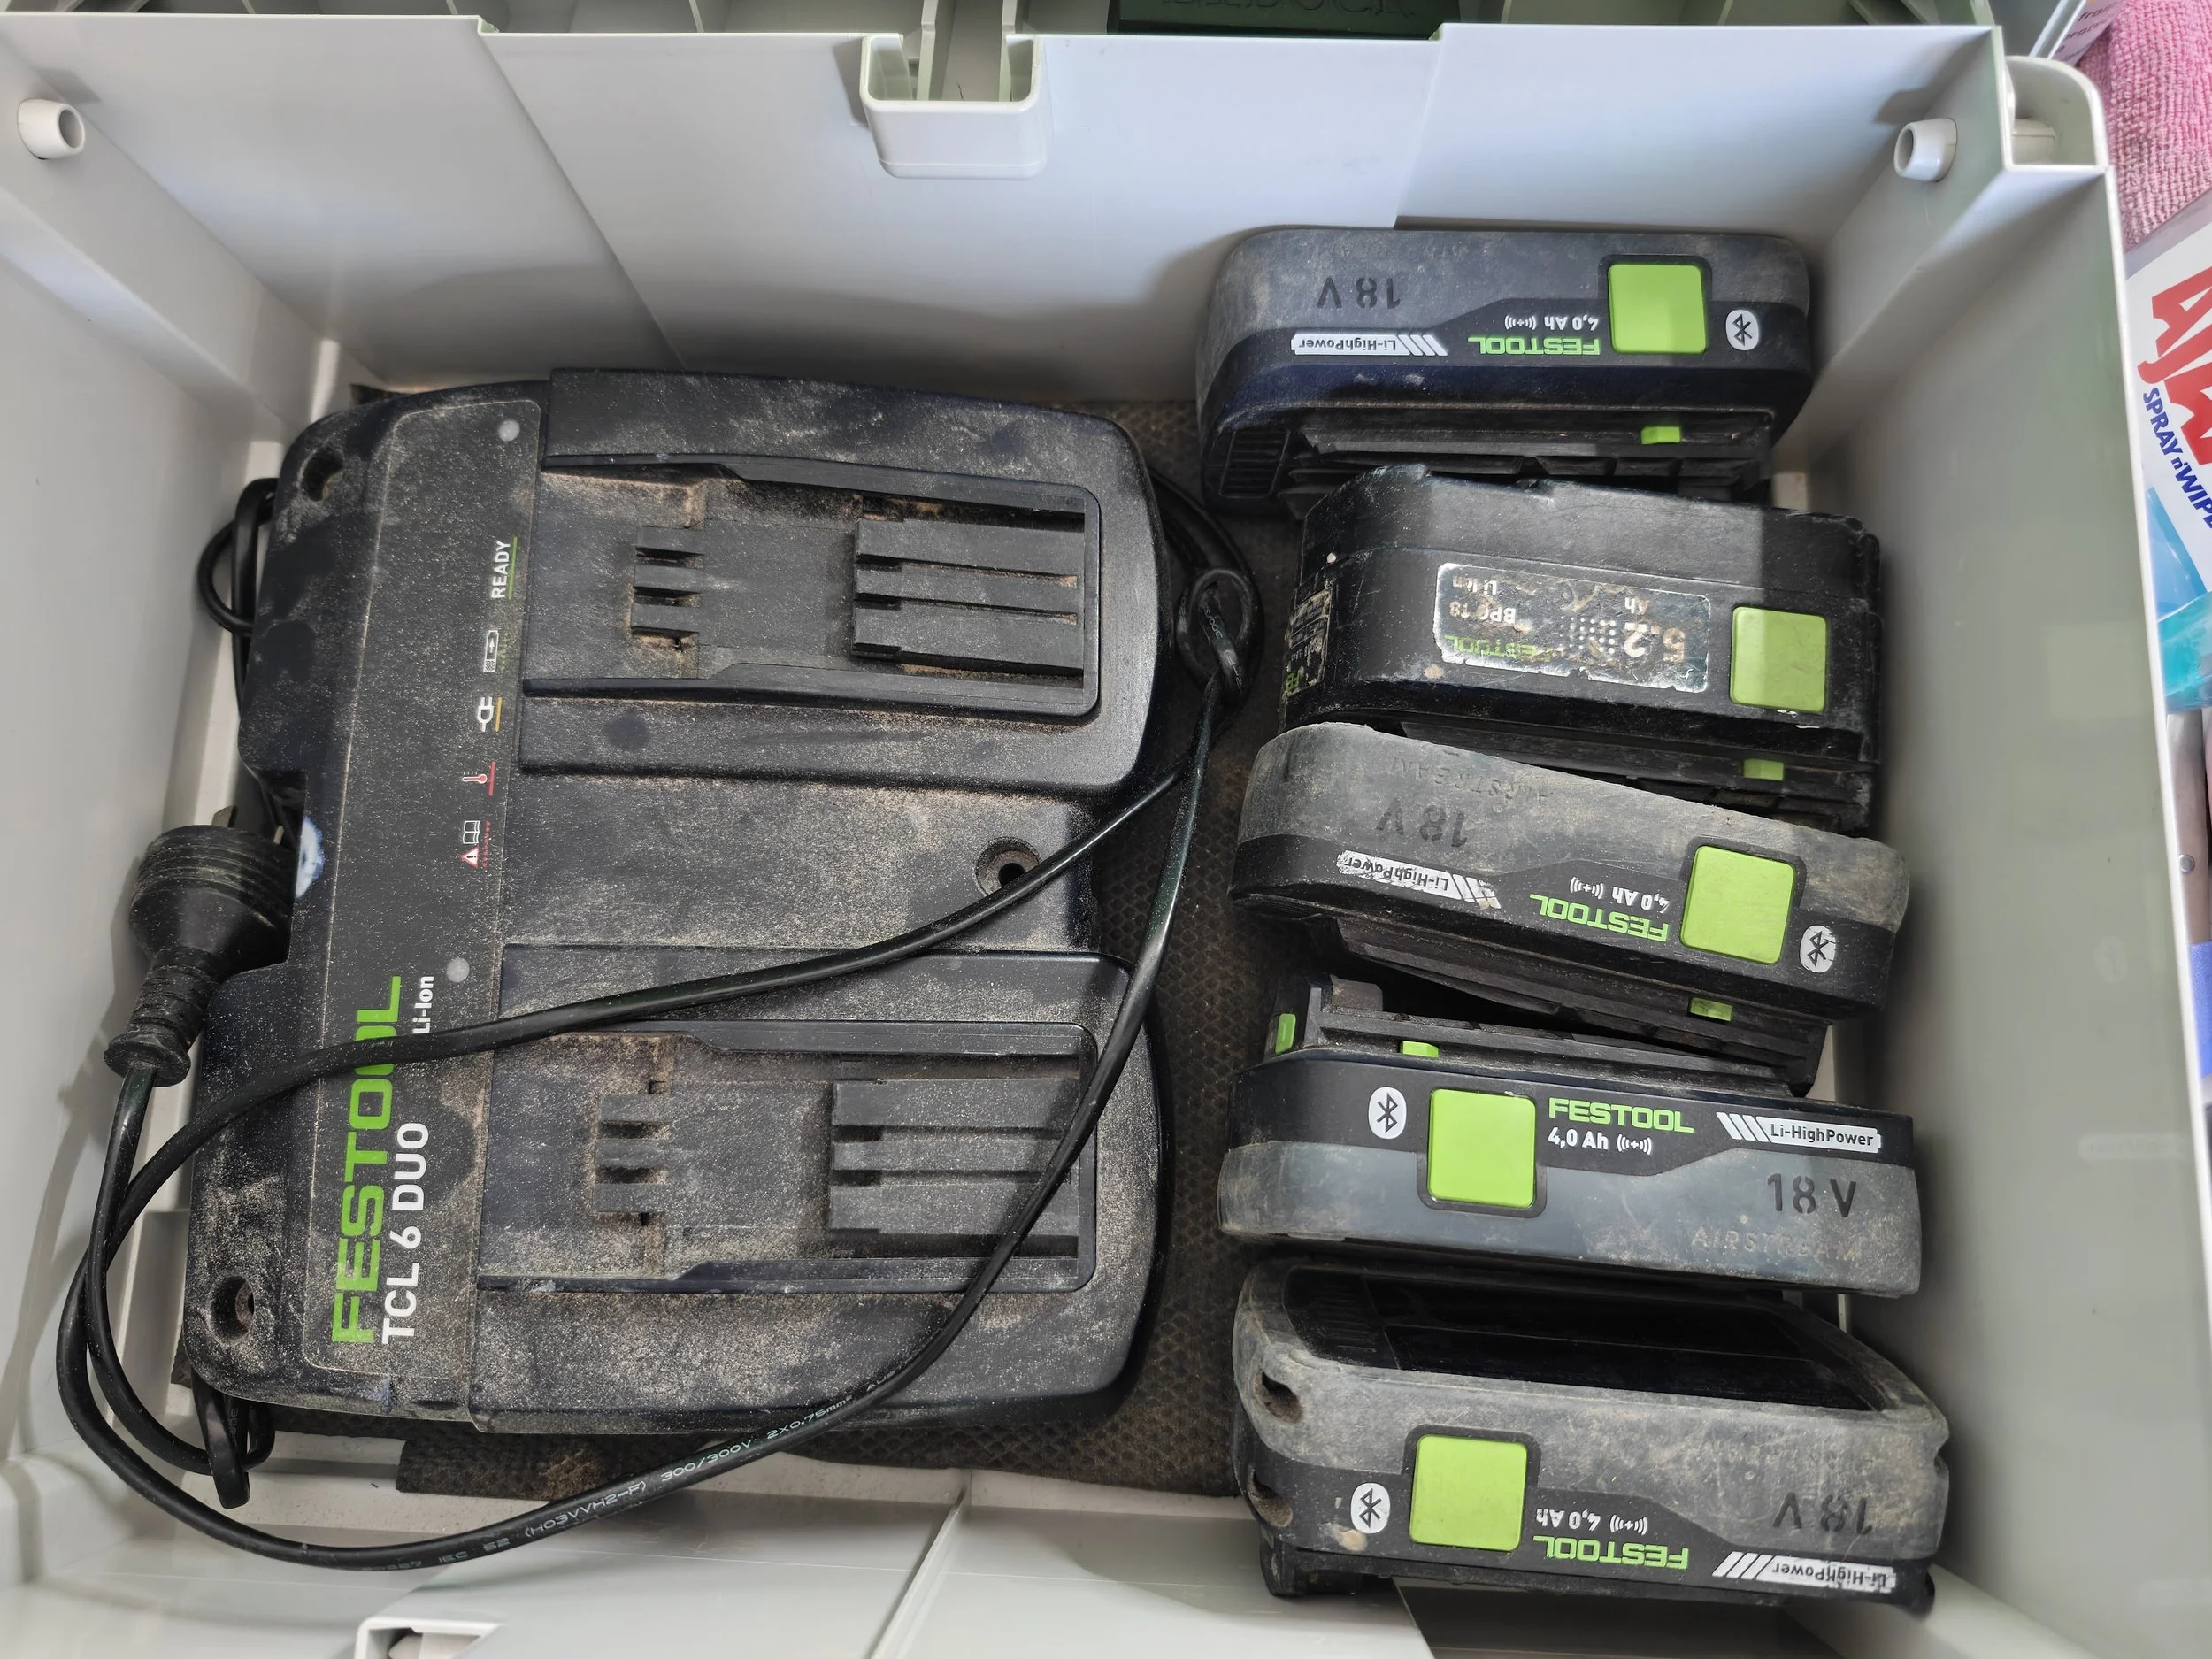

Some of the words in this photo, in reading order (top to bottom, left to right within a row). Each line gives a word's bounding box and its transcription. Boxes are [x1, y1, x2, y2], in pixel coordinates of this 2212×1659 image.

[1317, 276, 1342, 310] V
[1356, 276, 1401, 310] 18
[1544, 315, 1569, 331] Ah
[1572, 314, 1600, 331] 4,0
[1298, 337, 1397, 352] Li-HighPower
[1468, 335, 1601, 356] FESTOOL
[2142, 387, 2184, 456] SPRAY
[491, 540, 511, 600] READY
[1452, 576, 1498, 596] LiIon
[1444, 634, 1551, 663] ESTOOL
[1624, 621, 1686, 664] 5.2
[1376, 797, 1405, 835] V
[1420, 804, 1468, 848] 18
[1344, 856, 1449, 892] Li-HighPower
[1611, 886, 1640, 907] Ah
[1640, 893, 1671, 914] 4,0
[1529, 893, 1671, 942] FESTOOL
[411, 975, 434, 1034] Li-Ion
[1548, 1096, 1695, 1133] FESTOOL
[1548, 1126, 1578, 1148] 4,0
[1581, 1130, 1609, 1150] Ah
[1770, 1123, 1874, 1146] Li-HighPower
[392, 1121, 430, 1211] DUO
[1767, 1172, 1816, 1215] 18
[1829, 1178, 1857, 1218] V
[389, 1225, 422, 1248] 6
[381, 1261, 419, 1345] TCL
[661, 1439, 752, 1482] 300/300V
[1536, 1508, 1565, 1528] Ah
[1568, 1509, 1601, 1532] 4,0
[1772, 1492, 1802, 1529] V
[1820, 1494, 1873, 1535] 18
[1532, 1535, 1690, 1571] FESTOOL
[1771, 1563, 1887, 1588] Li-HighPower
